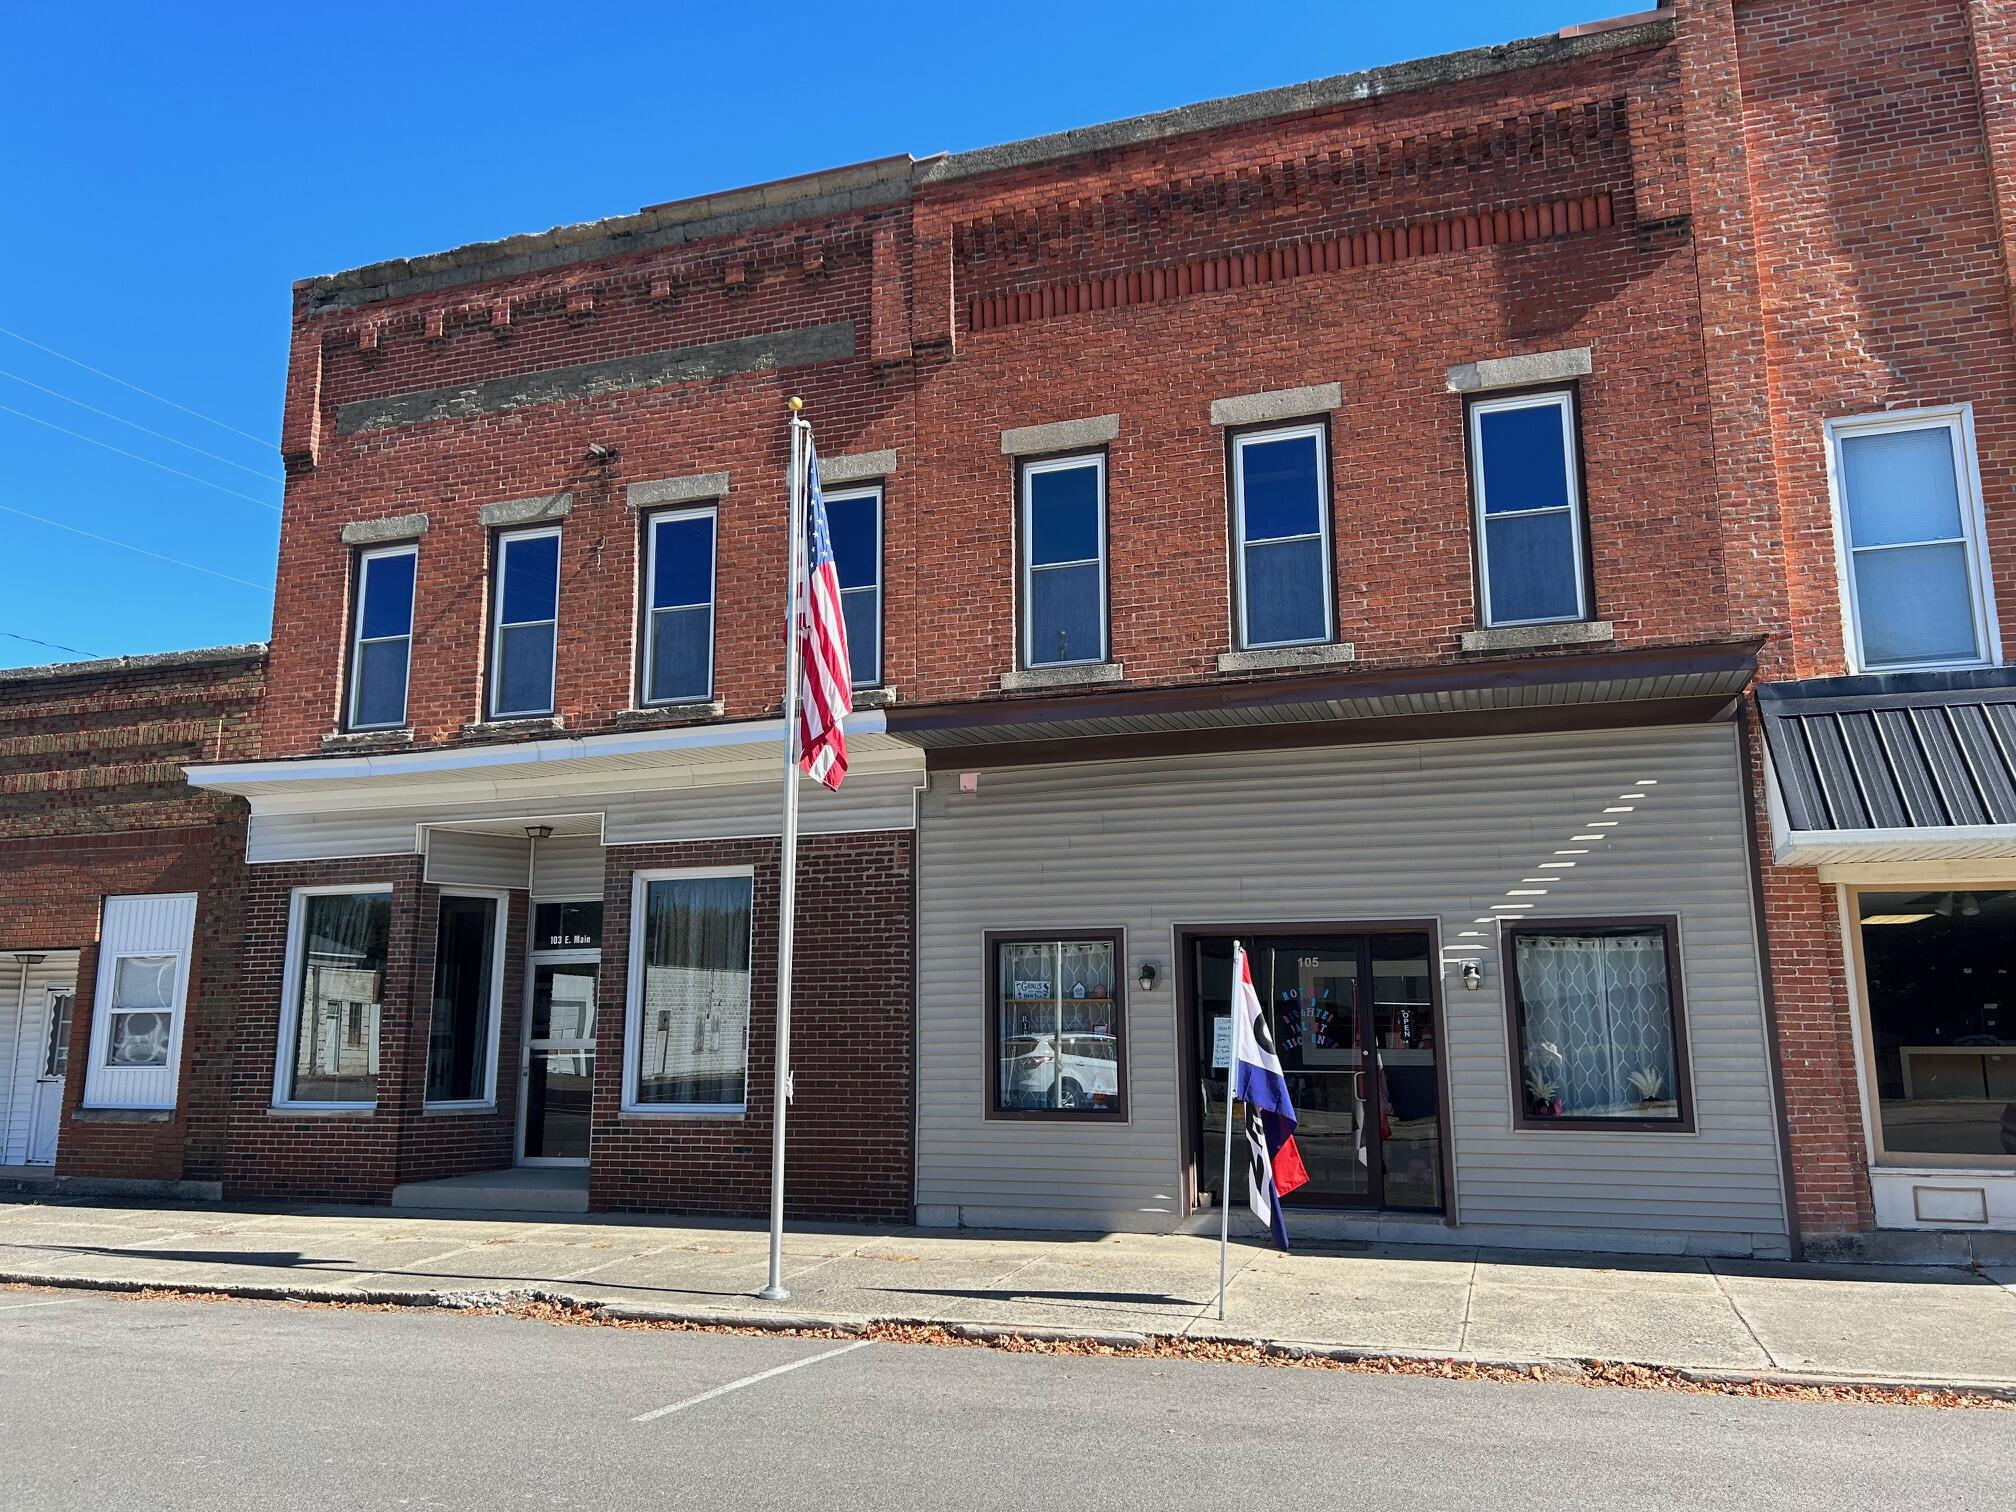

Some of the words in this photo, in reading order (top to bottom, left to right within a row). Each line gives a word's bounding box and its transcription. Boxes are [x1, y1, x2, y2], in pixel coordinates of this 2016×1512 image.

[550, 936, 562, 944] 103
[564, 936, 571, 944] E.
[574, 934, 590, 944] Main
[1297, 957, 1319, 968] 105
[1281, 985, 1330, 1001] MOTR
[1290, 1021, 1328, 1034] ALET
[1402, 1012, 1410, 1037] OPEN
[1281, 1033, 1339, 1051] ISCUN
